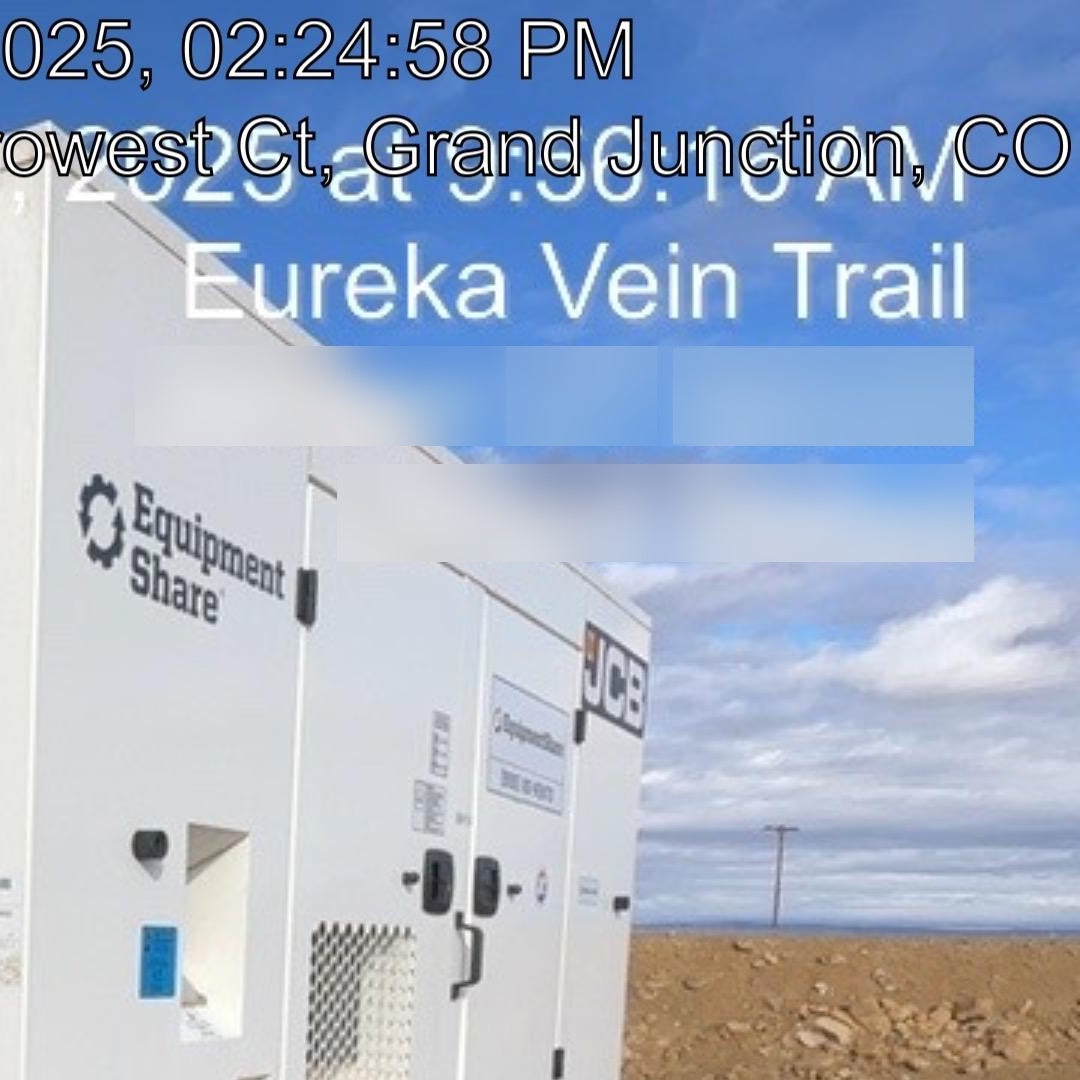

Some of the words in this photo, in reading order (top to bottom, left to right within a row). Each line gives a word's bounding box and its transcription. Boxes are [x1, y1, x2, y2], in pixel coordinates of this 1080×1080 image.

[130, 545, 220, 625] Share
[132, 482, 286, 600] Equipment
[583, 628, 647, 736] JCB
